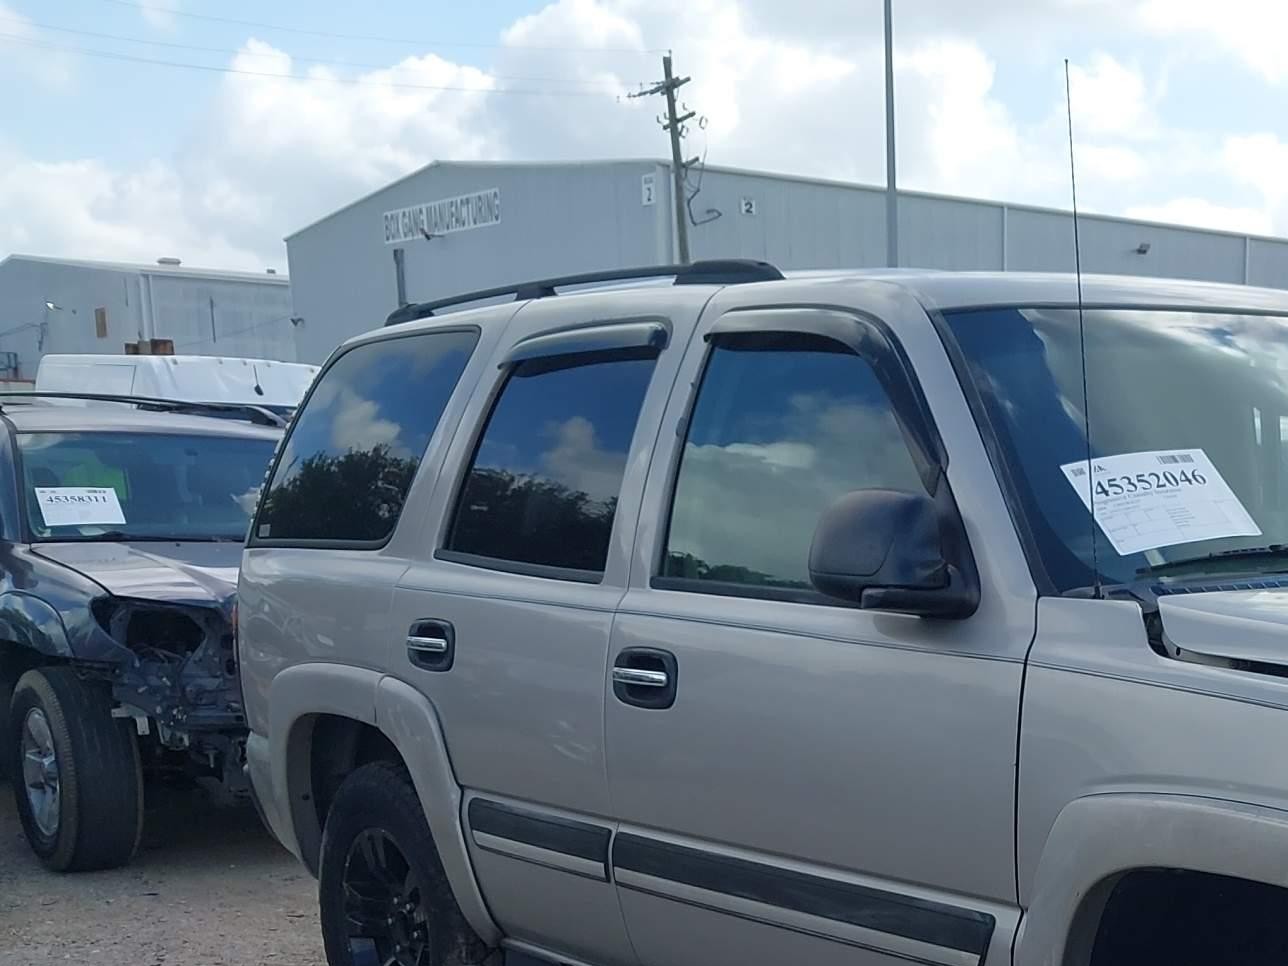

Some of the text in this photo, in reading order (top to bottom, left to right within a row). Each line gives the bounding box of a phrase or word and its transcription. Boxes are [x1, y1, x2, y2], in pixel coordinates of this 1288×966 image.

[426, 190, 499, 233] MANUFACTURING
[744, 201, 753, 213] 2
[1095, 469, 1207, 497] 45352046
